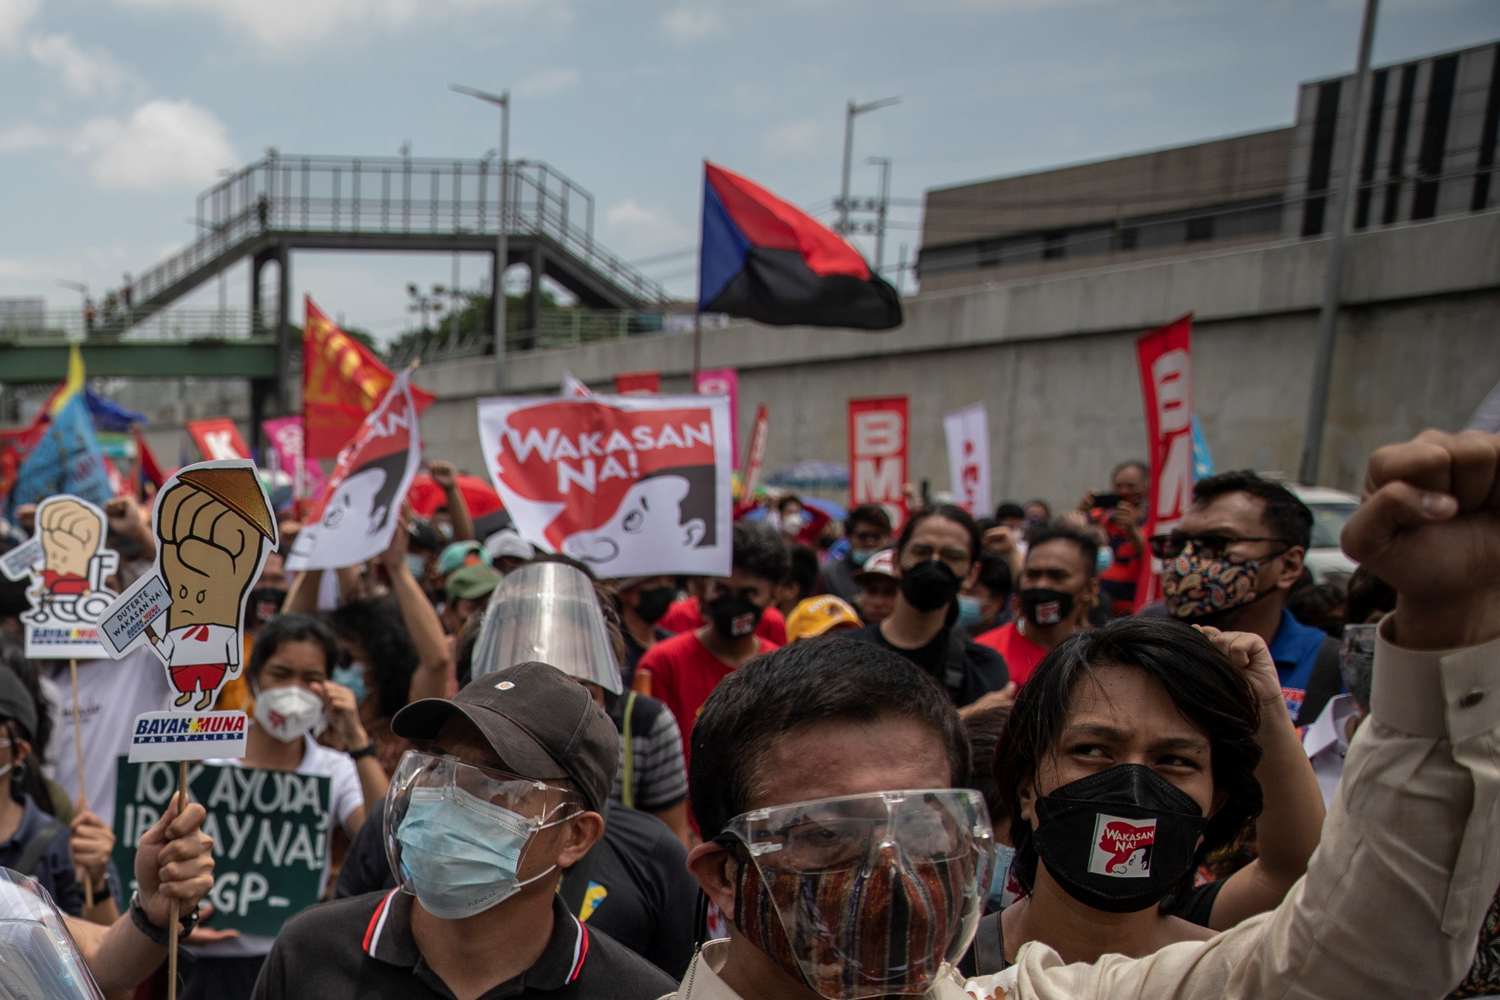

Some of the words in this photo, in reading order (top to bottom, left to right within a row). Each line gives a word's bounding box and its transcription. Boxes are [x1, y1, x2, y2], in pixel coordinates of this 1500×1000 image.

[507, 421, 714, 464] WAKASAN
[558, 452, 641, 494] NA!
[113, 602, 149, 637] WAKASAN
[116, 590, 149, 622] DUTERTE
[135, 717, 192, 735] BAYAN
[195, 716, 245, 733] MUNA
[1105, 828, 1154, 842] WAKASAN
[1114, 840, 1137, 853] NA!
